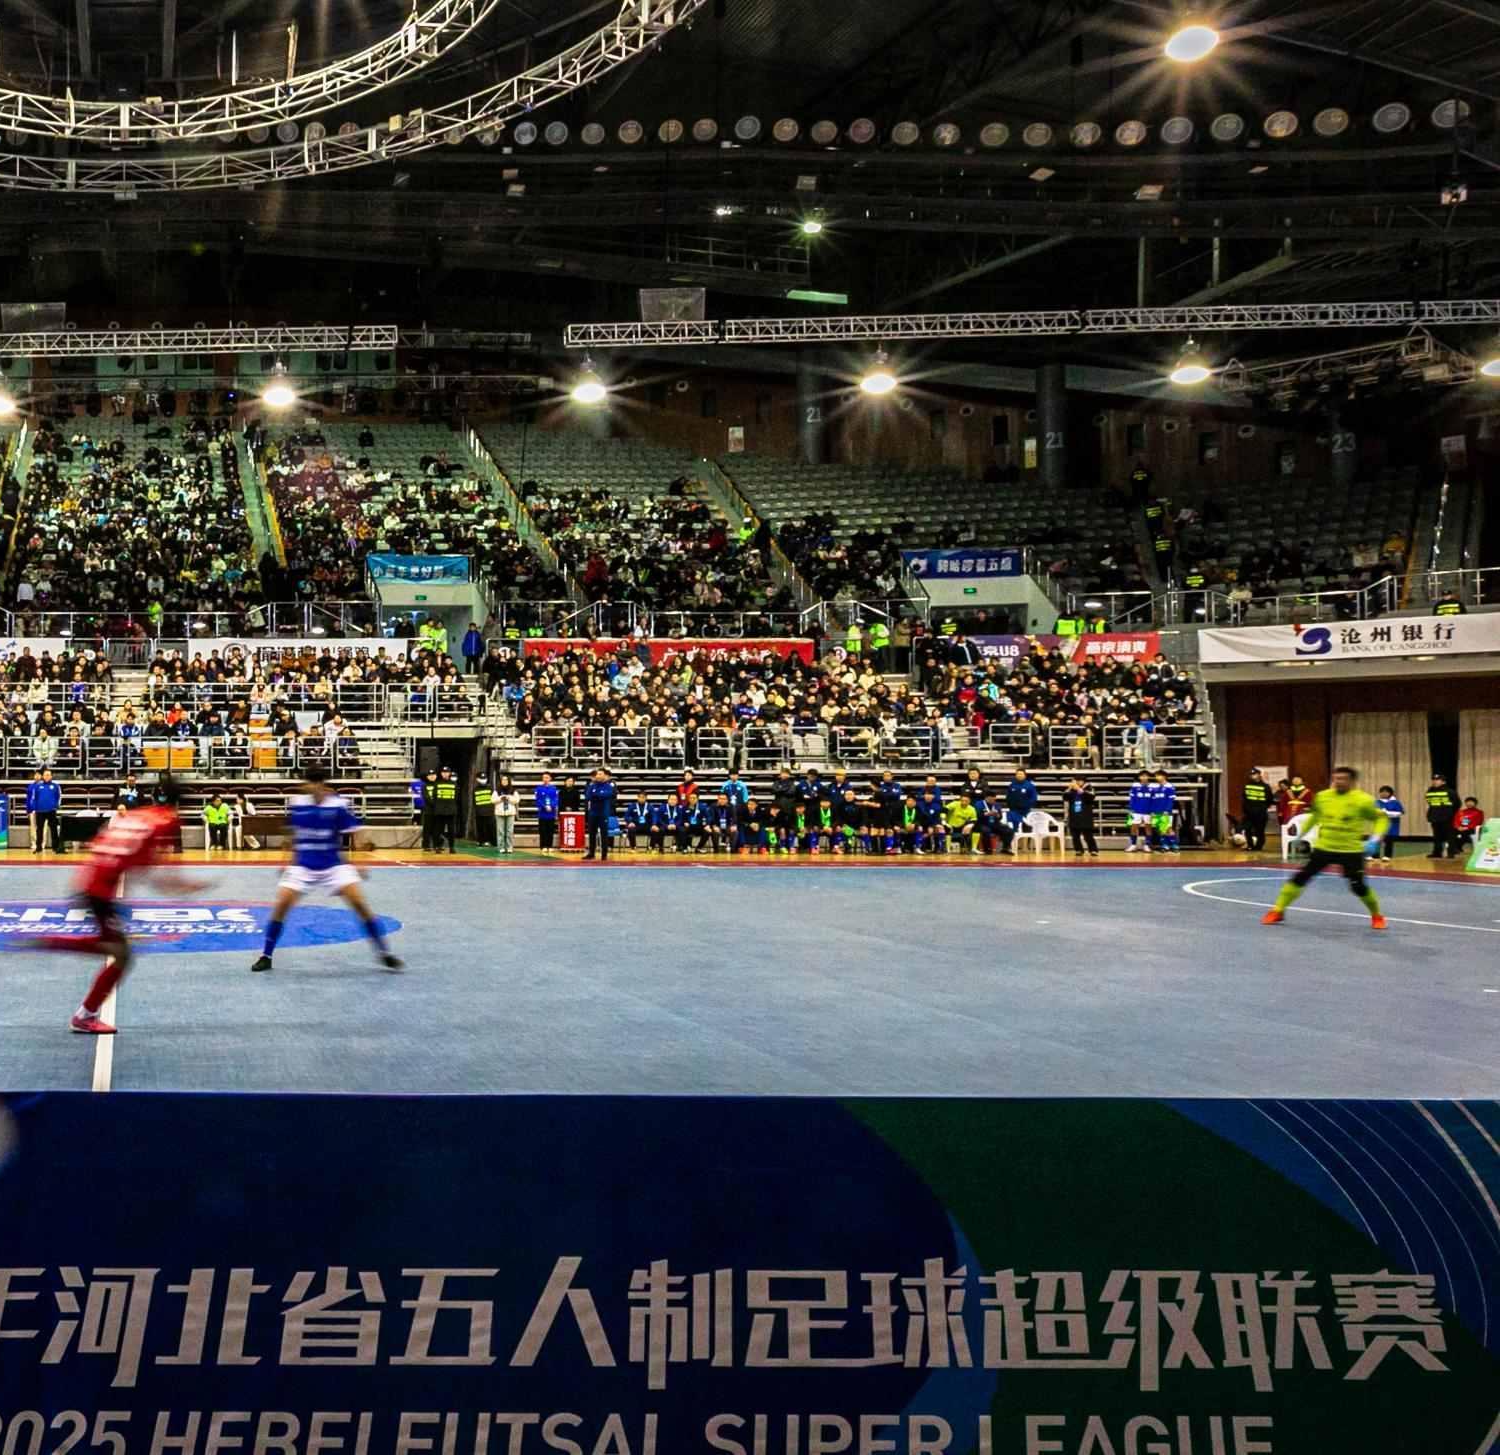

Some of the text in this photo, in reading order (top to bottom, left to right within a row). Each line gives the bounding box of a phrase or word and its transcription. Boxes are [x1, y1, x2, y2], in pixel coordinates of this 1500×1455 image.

[806, 406, 823, 424] 21
[1045, 431, 1064, 449] 21
[1331, 433, 1357, 454] 23
[1340, 622, 1456, 645] 沧州银行
[978, 645, 1019, 657] 京U8
[150, 1410, 372, 1455] HEBEI
[704, 1413, 954, 1455] SUPER
